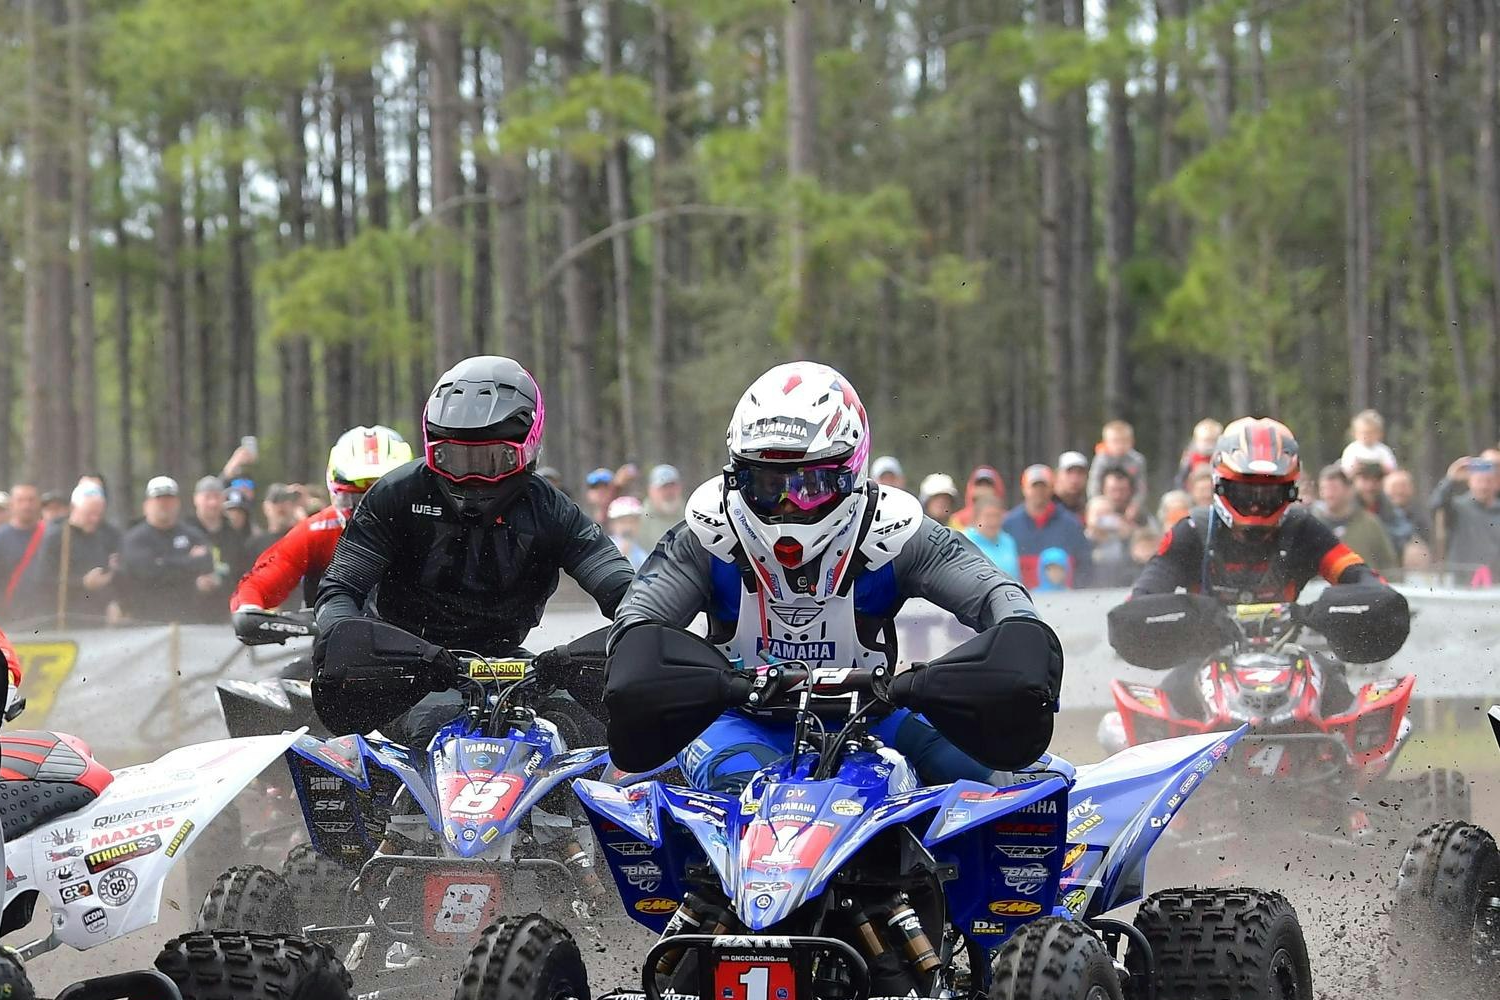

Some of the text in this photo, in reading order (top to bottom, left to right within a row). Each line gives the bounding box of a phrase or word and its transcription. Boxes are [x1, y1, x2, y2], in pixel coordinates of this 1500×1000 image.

[473, 663, 522, 673] RECISION
[464, 742, 506, 755] YAMAHA
[1248, 745, 1284, 776] 4
[314, 801, 346, 811] SSI
[780, 803, 816, 813] YAMAHA
[1016, 800, 1058, 814] MAHA
[91, 816, 176, 849] MAXXIS
[88, 841, 140, 867] ITHACA
[1001, 867, 1050, 877] BNR
[109, 879, 127, 896] 88
[433, 884, 491, 933] 8
[988, 902, 1042, 914] FMF
[84, 909, 105, 925] ICON
